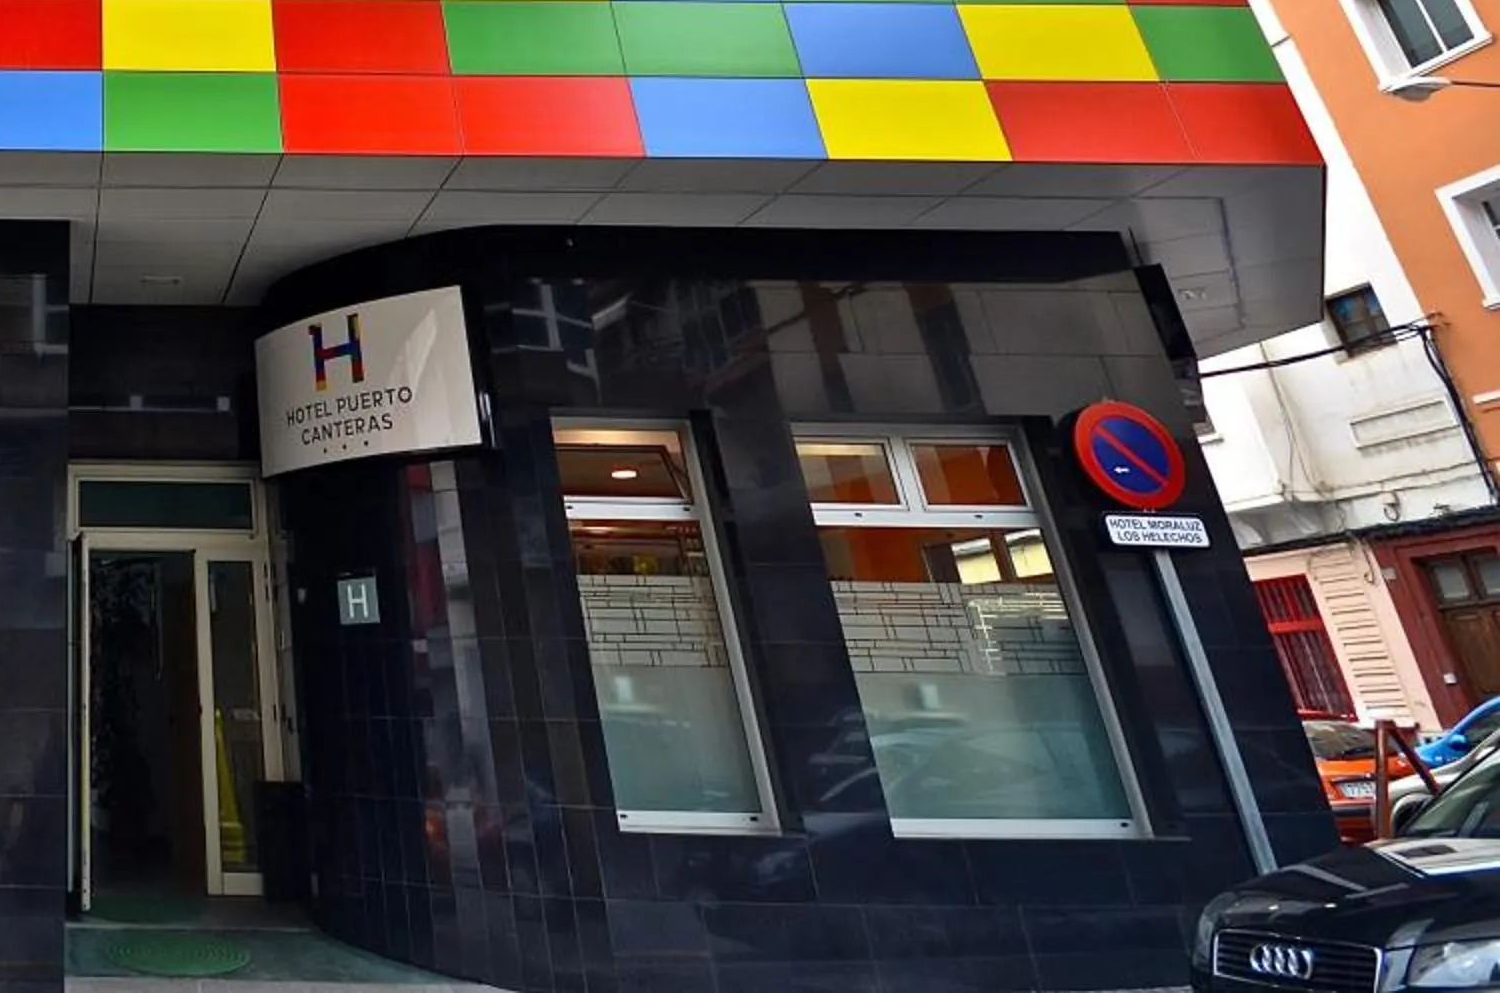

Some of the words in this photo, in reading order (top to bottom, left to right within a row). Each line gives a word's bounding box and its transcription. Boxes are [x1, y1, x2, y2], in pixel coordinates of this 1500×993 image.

[308, 313, 365, 392] H
[286, 402, 333, 427] HOTEL
[335, 386, 413, 414] PUERTO
[301, 413, 394, 446] CANTERAS
[1109, 518, 1147, 530] HOTEL
[1117, 530, 1141, 542] LOS
[347, 584, 369, 619] H
